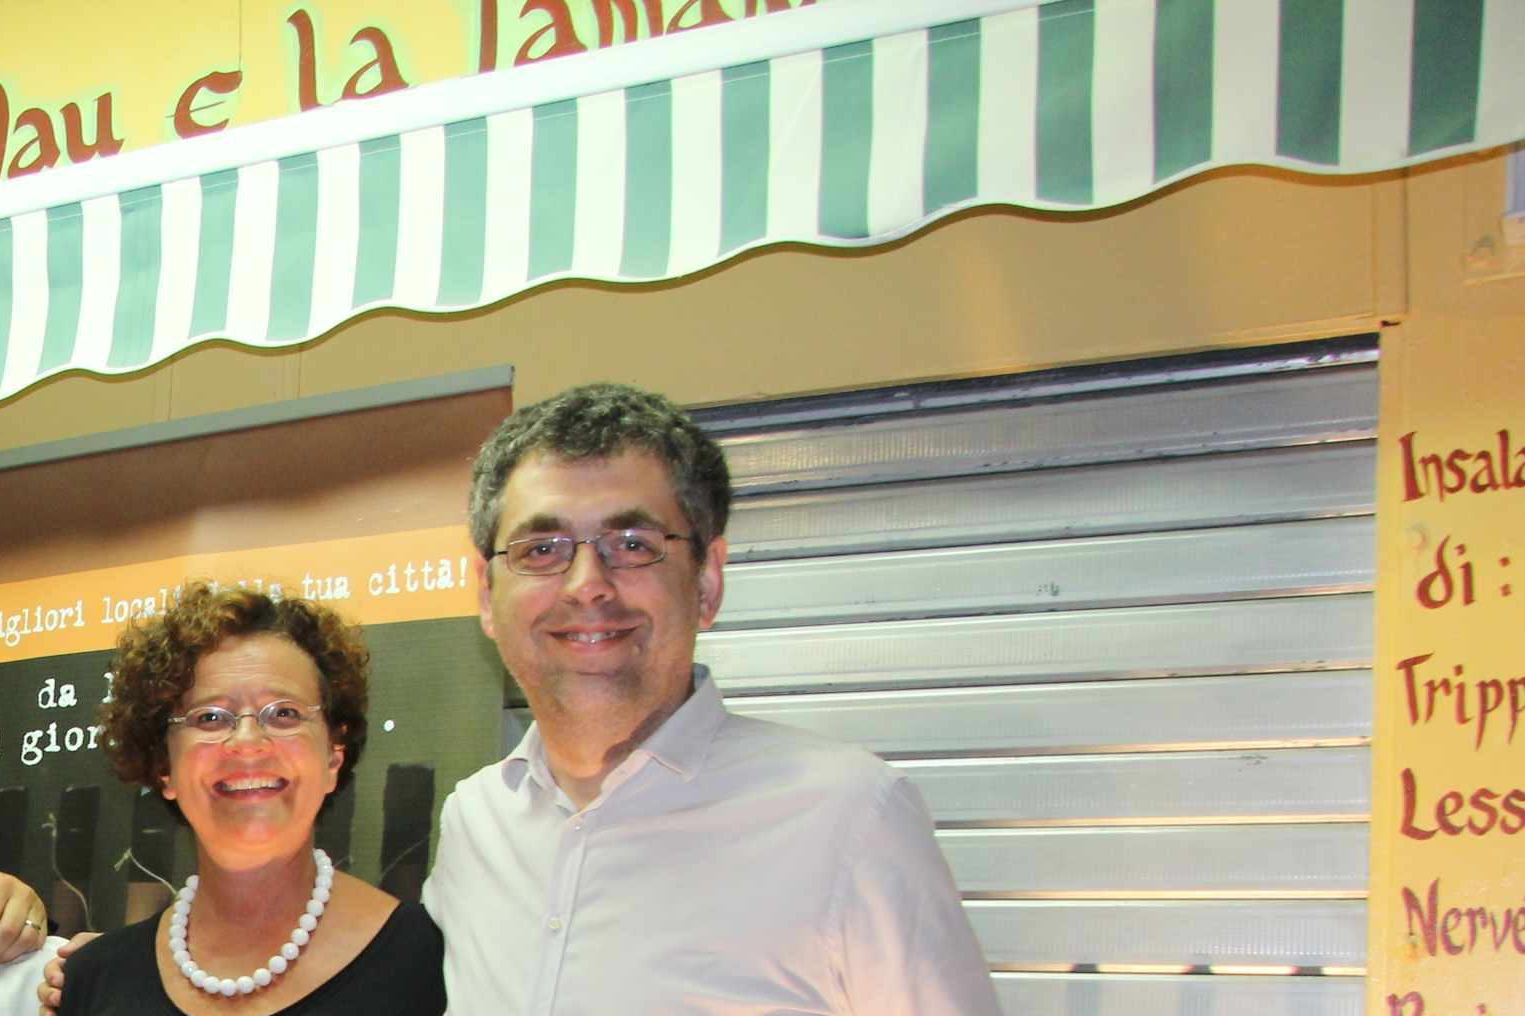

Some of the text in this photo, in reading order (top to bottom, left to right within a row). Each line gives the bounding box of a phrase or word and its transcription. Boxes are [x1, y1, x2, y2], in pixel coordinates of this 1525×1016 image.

[287, 9, 410, 110] la
[301, 571, 352, 601] tua
[37, 678, 79, 710] da
